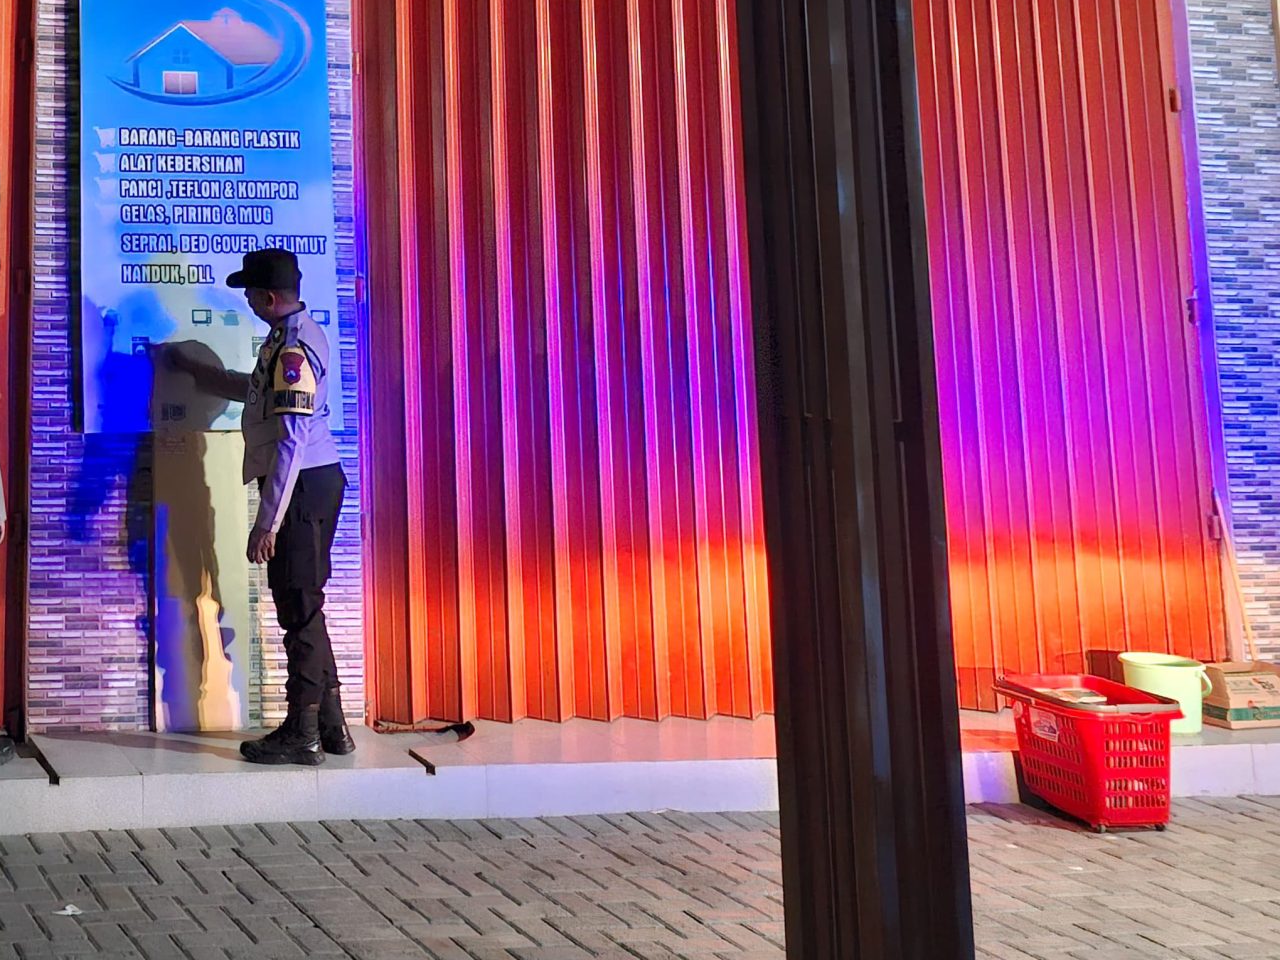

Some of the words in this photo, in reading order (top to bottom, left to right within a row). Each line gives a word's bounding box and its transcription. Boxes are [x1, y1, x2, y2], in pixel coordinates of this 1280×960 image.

[120, 128, 240, 148] BARANG-BARANG
[244, 130, 300, 149] PLASTIK
[120, 154, 153, 172] ALAT
[157, 155, 244, 174] KEBERSIHAN
[120, 180, 162, 198] PANCI
[223, 181, 235, 199] &
[237, 181, 298, 200] KOMPOR
[121, 204, 170, 224] GELAS,
[173, 205, 221, 224] PIRING
[224, 206, 236, 224] &
[238, 206, 273, 225] MUG
[121, 233, 177, 254] SEPRAI,
[180, 234, 210, 253] BED
[265, 235, 326, 254] SELIMUT
[122, 264, 184, 284] HANDUK,
[188, 265, 215, 284] DLL
